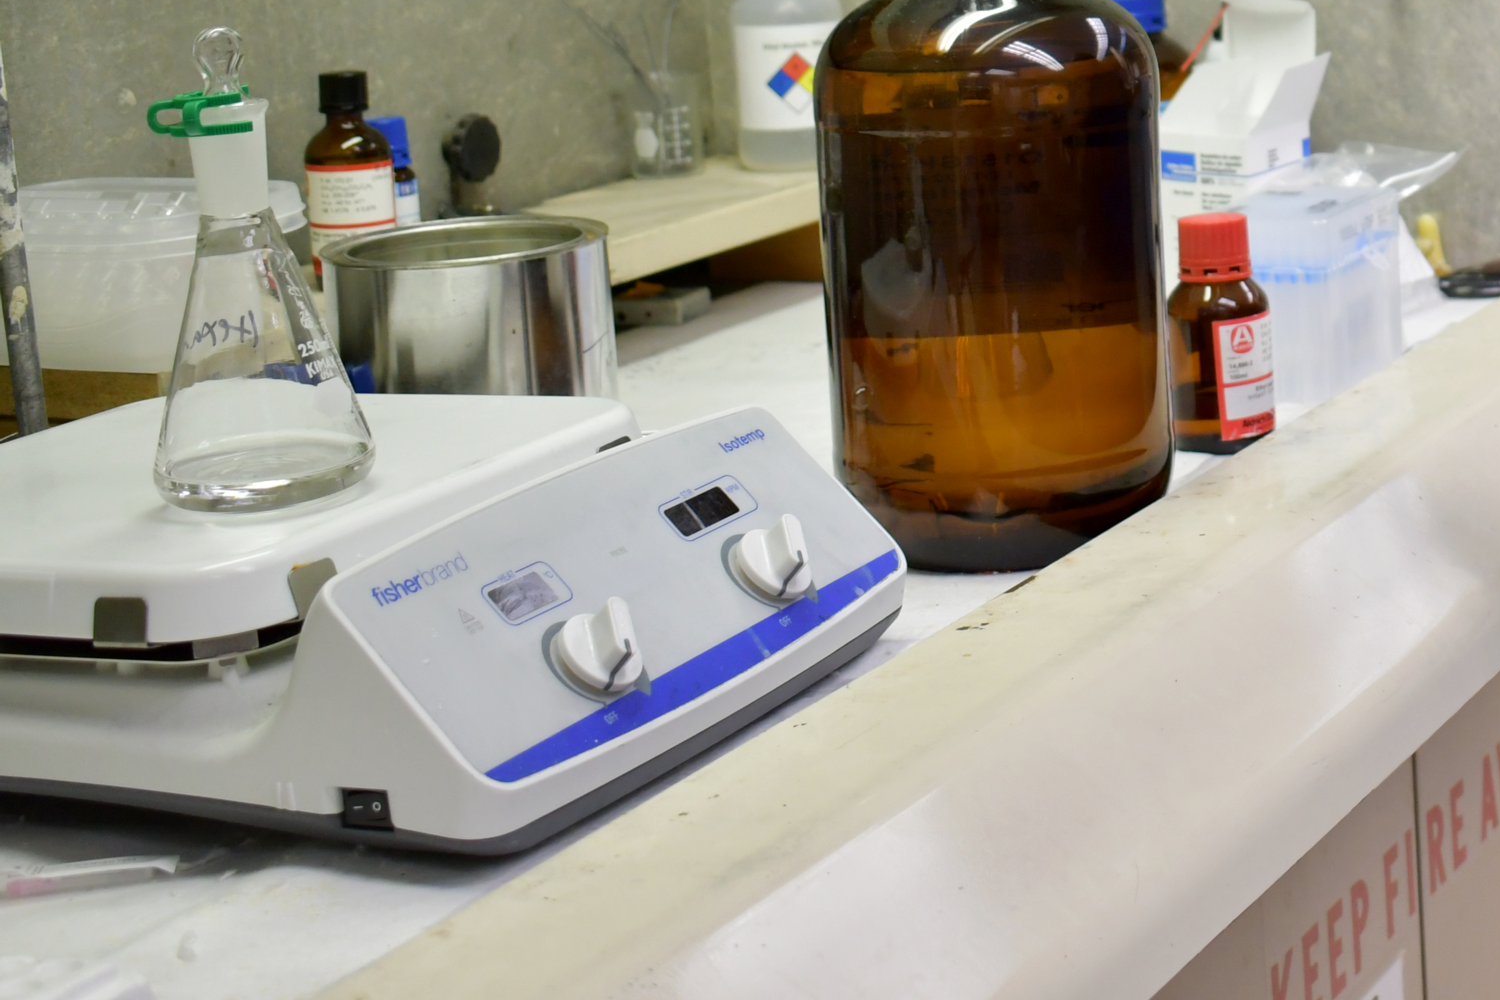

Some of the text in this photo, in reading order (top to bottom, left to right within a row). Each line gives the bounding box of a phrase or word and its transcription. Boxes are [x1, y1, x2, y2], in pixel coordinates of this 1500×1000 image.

[305, 356, 336, 379] KIMAX
[718, 428, 765, 453] Isotemp
[680, 488, 695, 500] STIR
[371, 552, 469, 607] fisherbrand
[779, 614, 793, 628] OFF
[603, 710, 619, 726] OFF
[1270, 876, 1370, 1000] KEEP
[1383, 778, 1468, 941] FIRE
